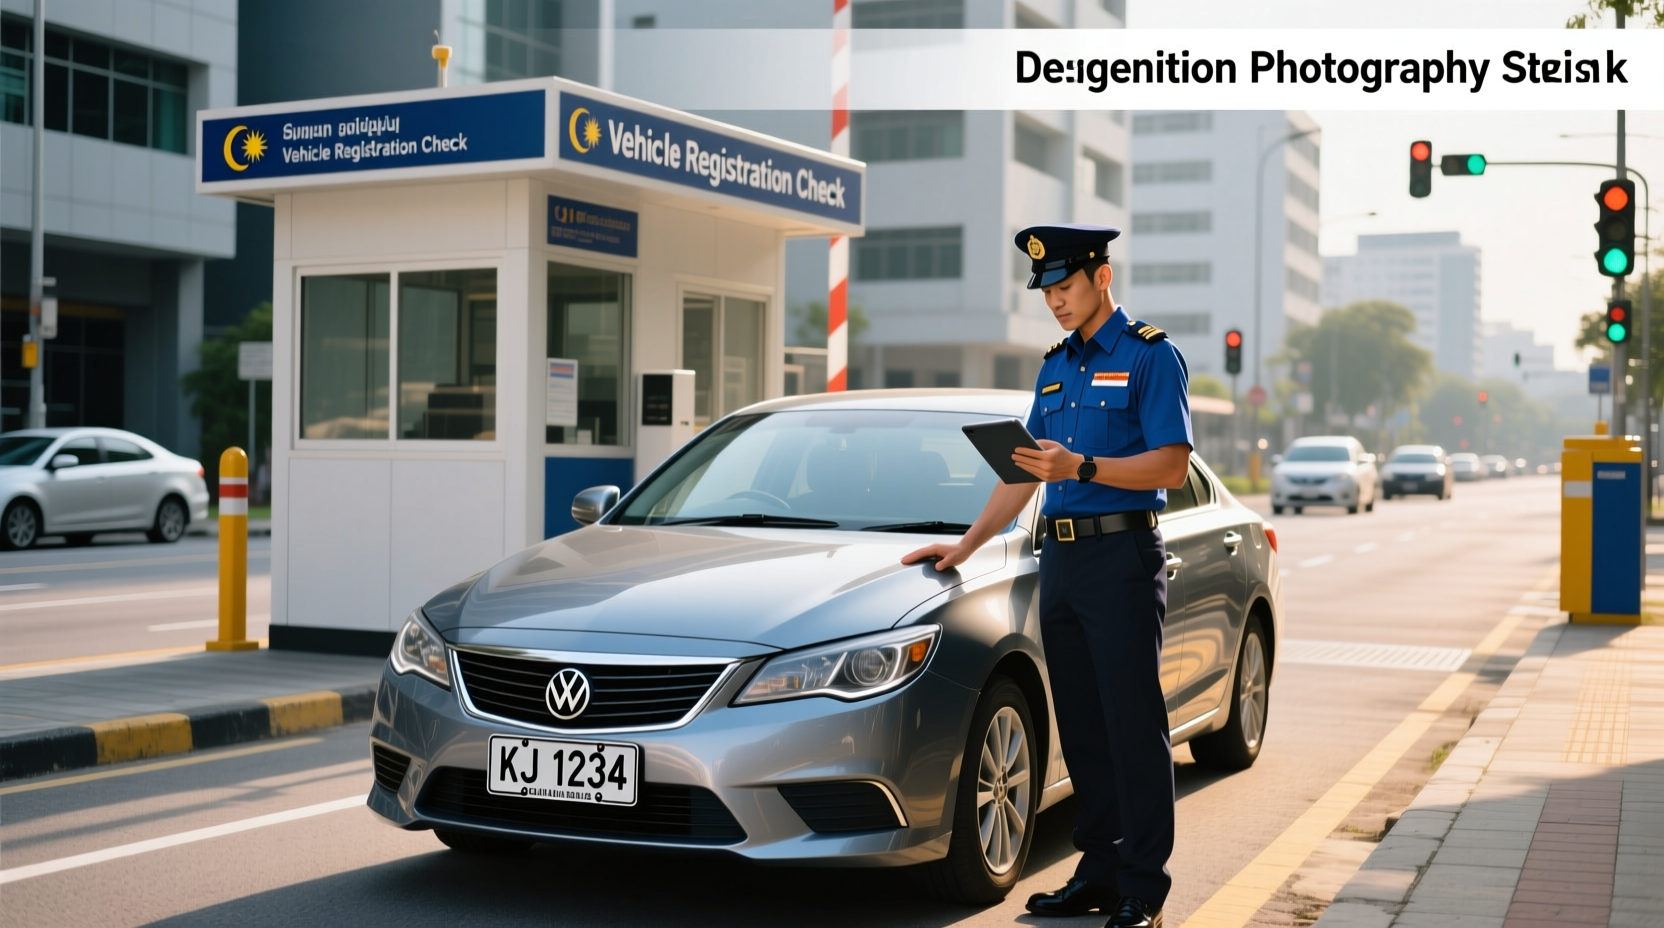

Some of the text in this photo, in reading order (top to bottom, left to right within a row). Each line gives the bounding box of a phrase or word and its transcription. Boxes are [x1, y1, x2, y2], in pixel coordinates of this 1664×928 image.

[283, 132, 468, 163] Vehicle Registration Check
[608, 119, 846, 209] Vehicle Registration Check
[500, 745, 627, 791] KJ 1234
